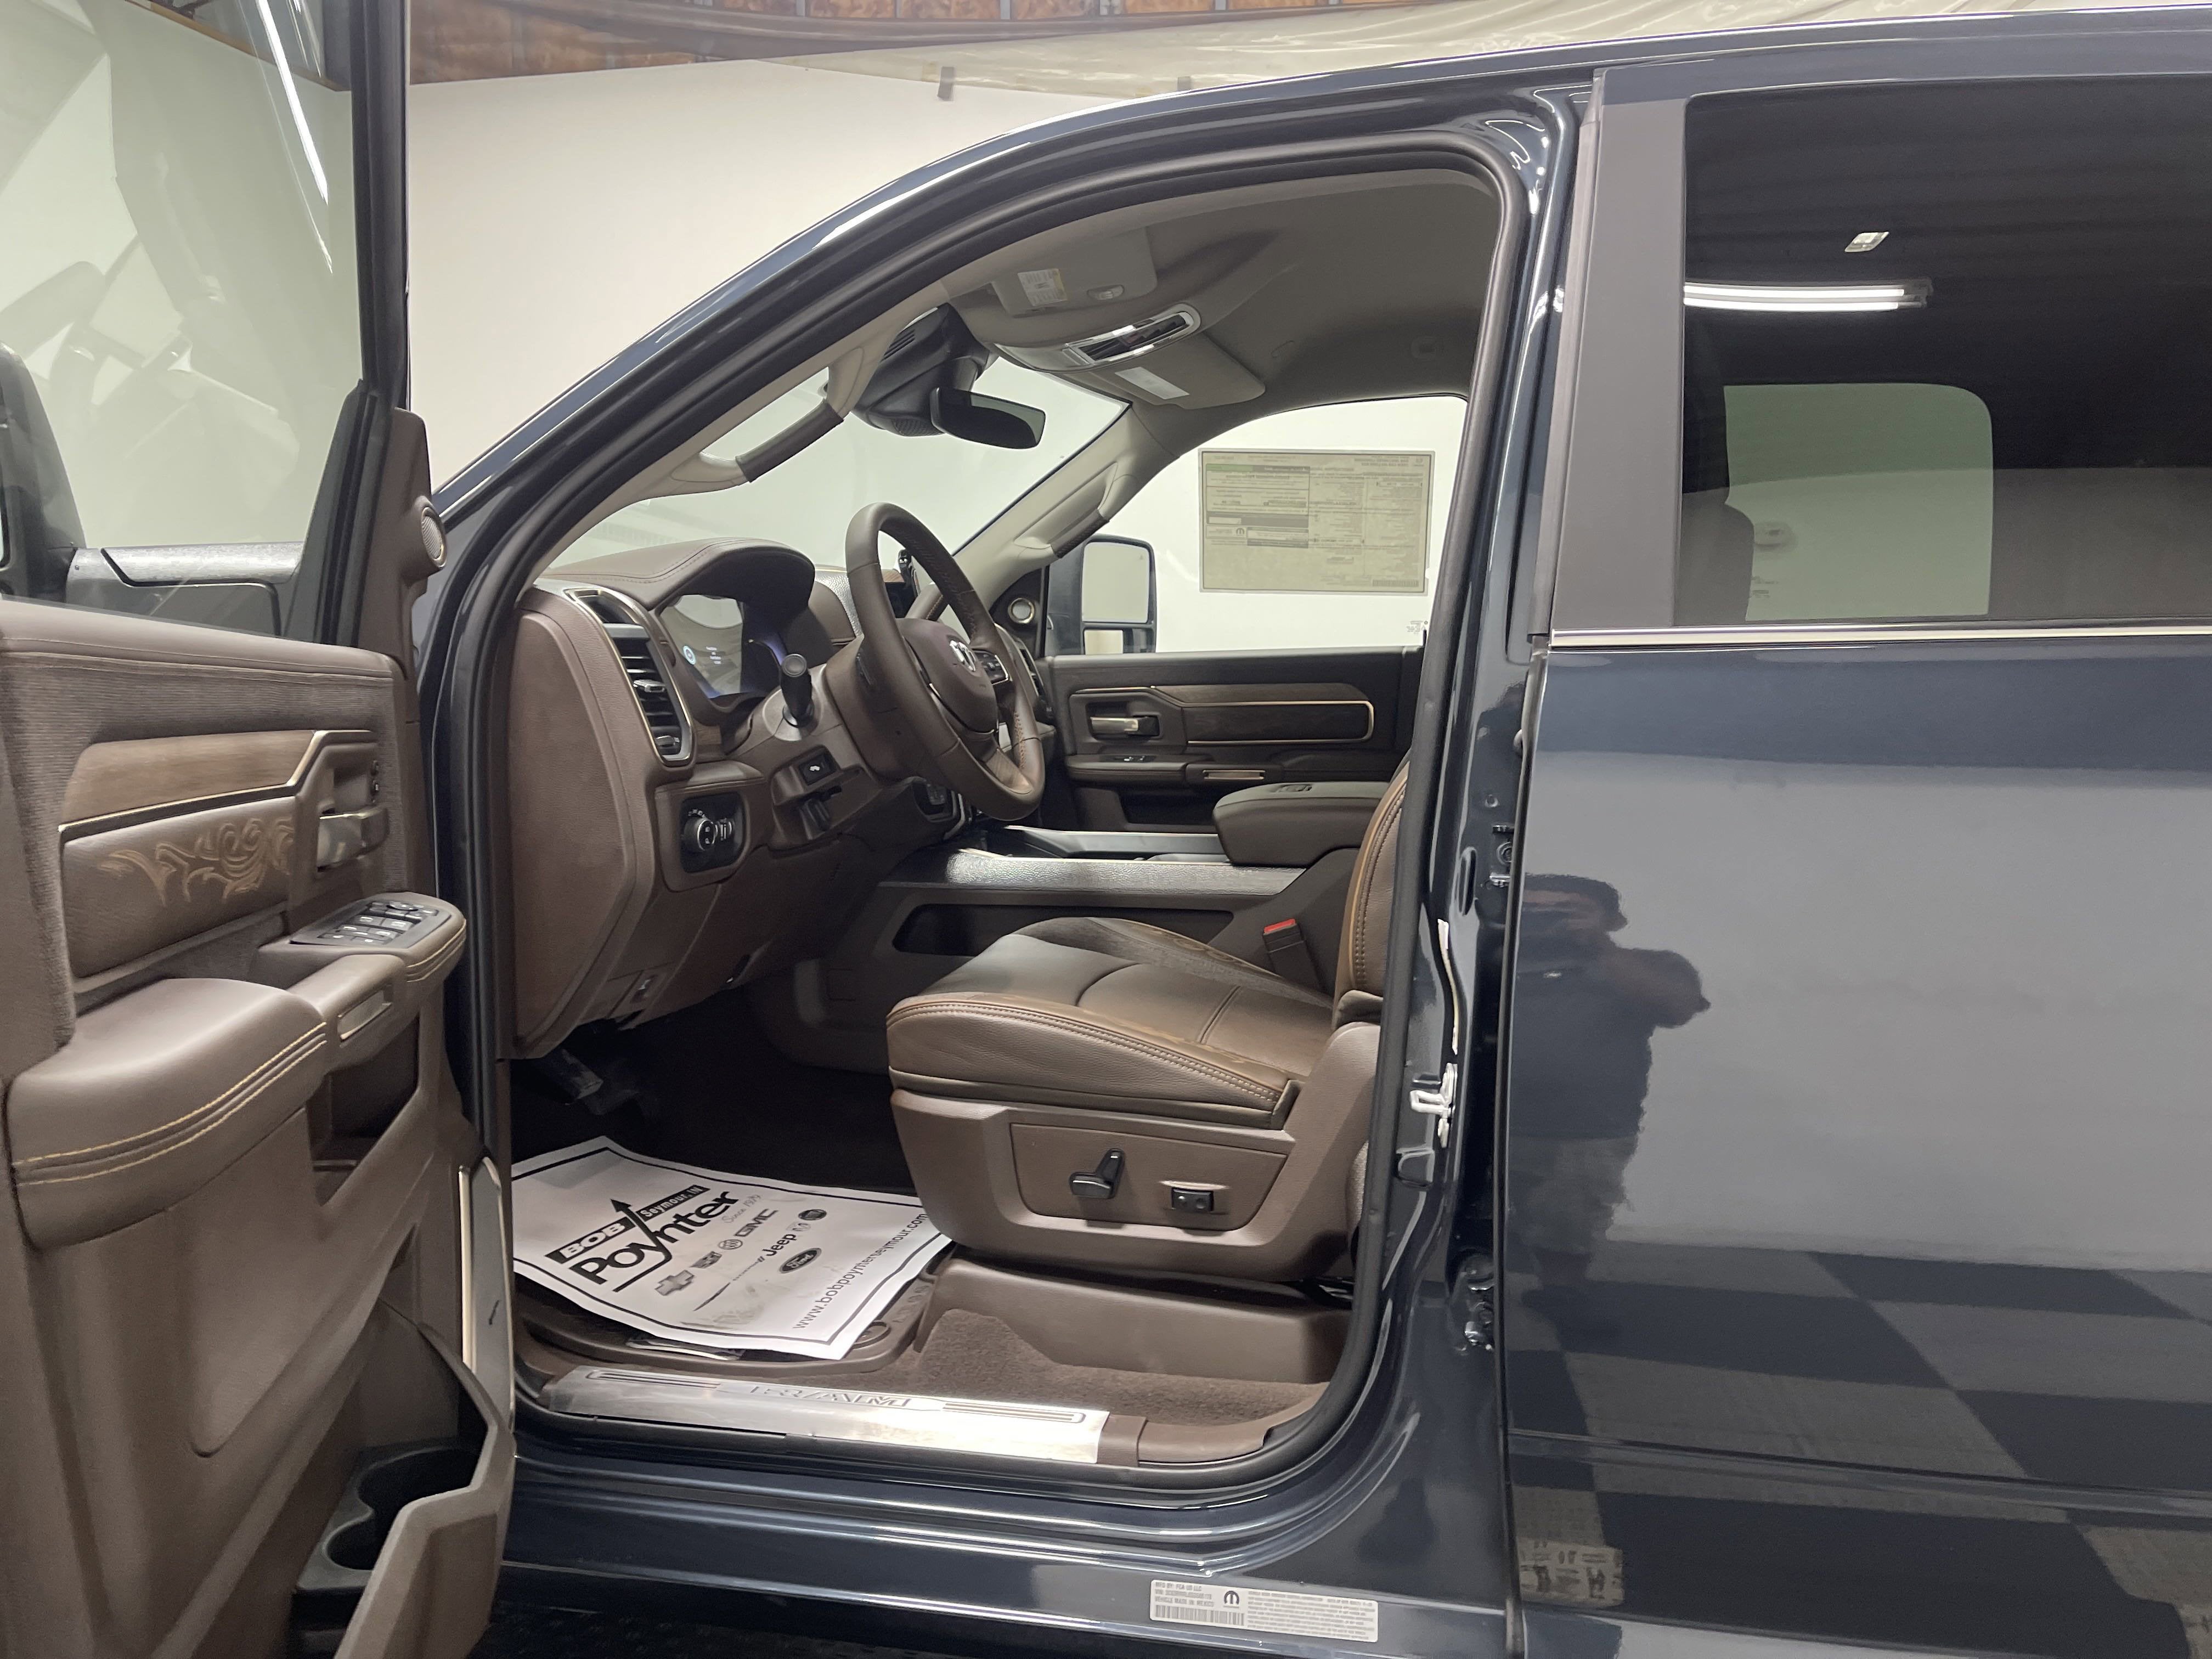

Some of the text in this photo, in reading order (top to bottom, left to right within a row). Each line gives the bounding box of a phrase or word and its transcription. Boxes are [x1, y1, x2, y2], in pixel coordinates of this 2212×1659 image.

[734, 1208, 780, 1237] GMC
[559, 1222, 625, 1259] BOB
[569, 1191, 739, 1292] Poynter
[761, 1233, 798, 1257] Jeep
[786, 1253, 814, 1268] Ford
[793, 1213, 929, 1329] www.bobpoynterseymour.com
[750, 1386, 912, 1408] RAM
